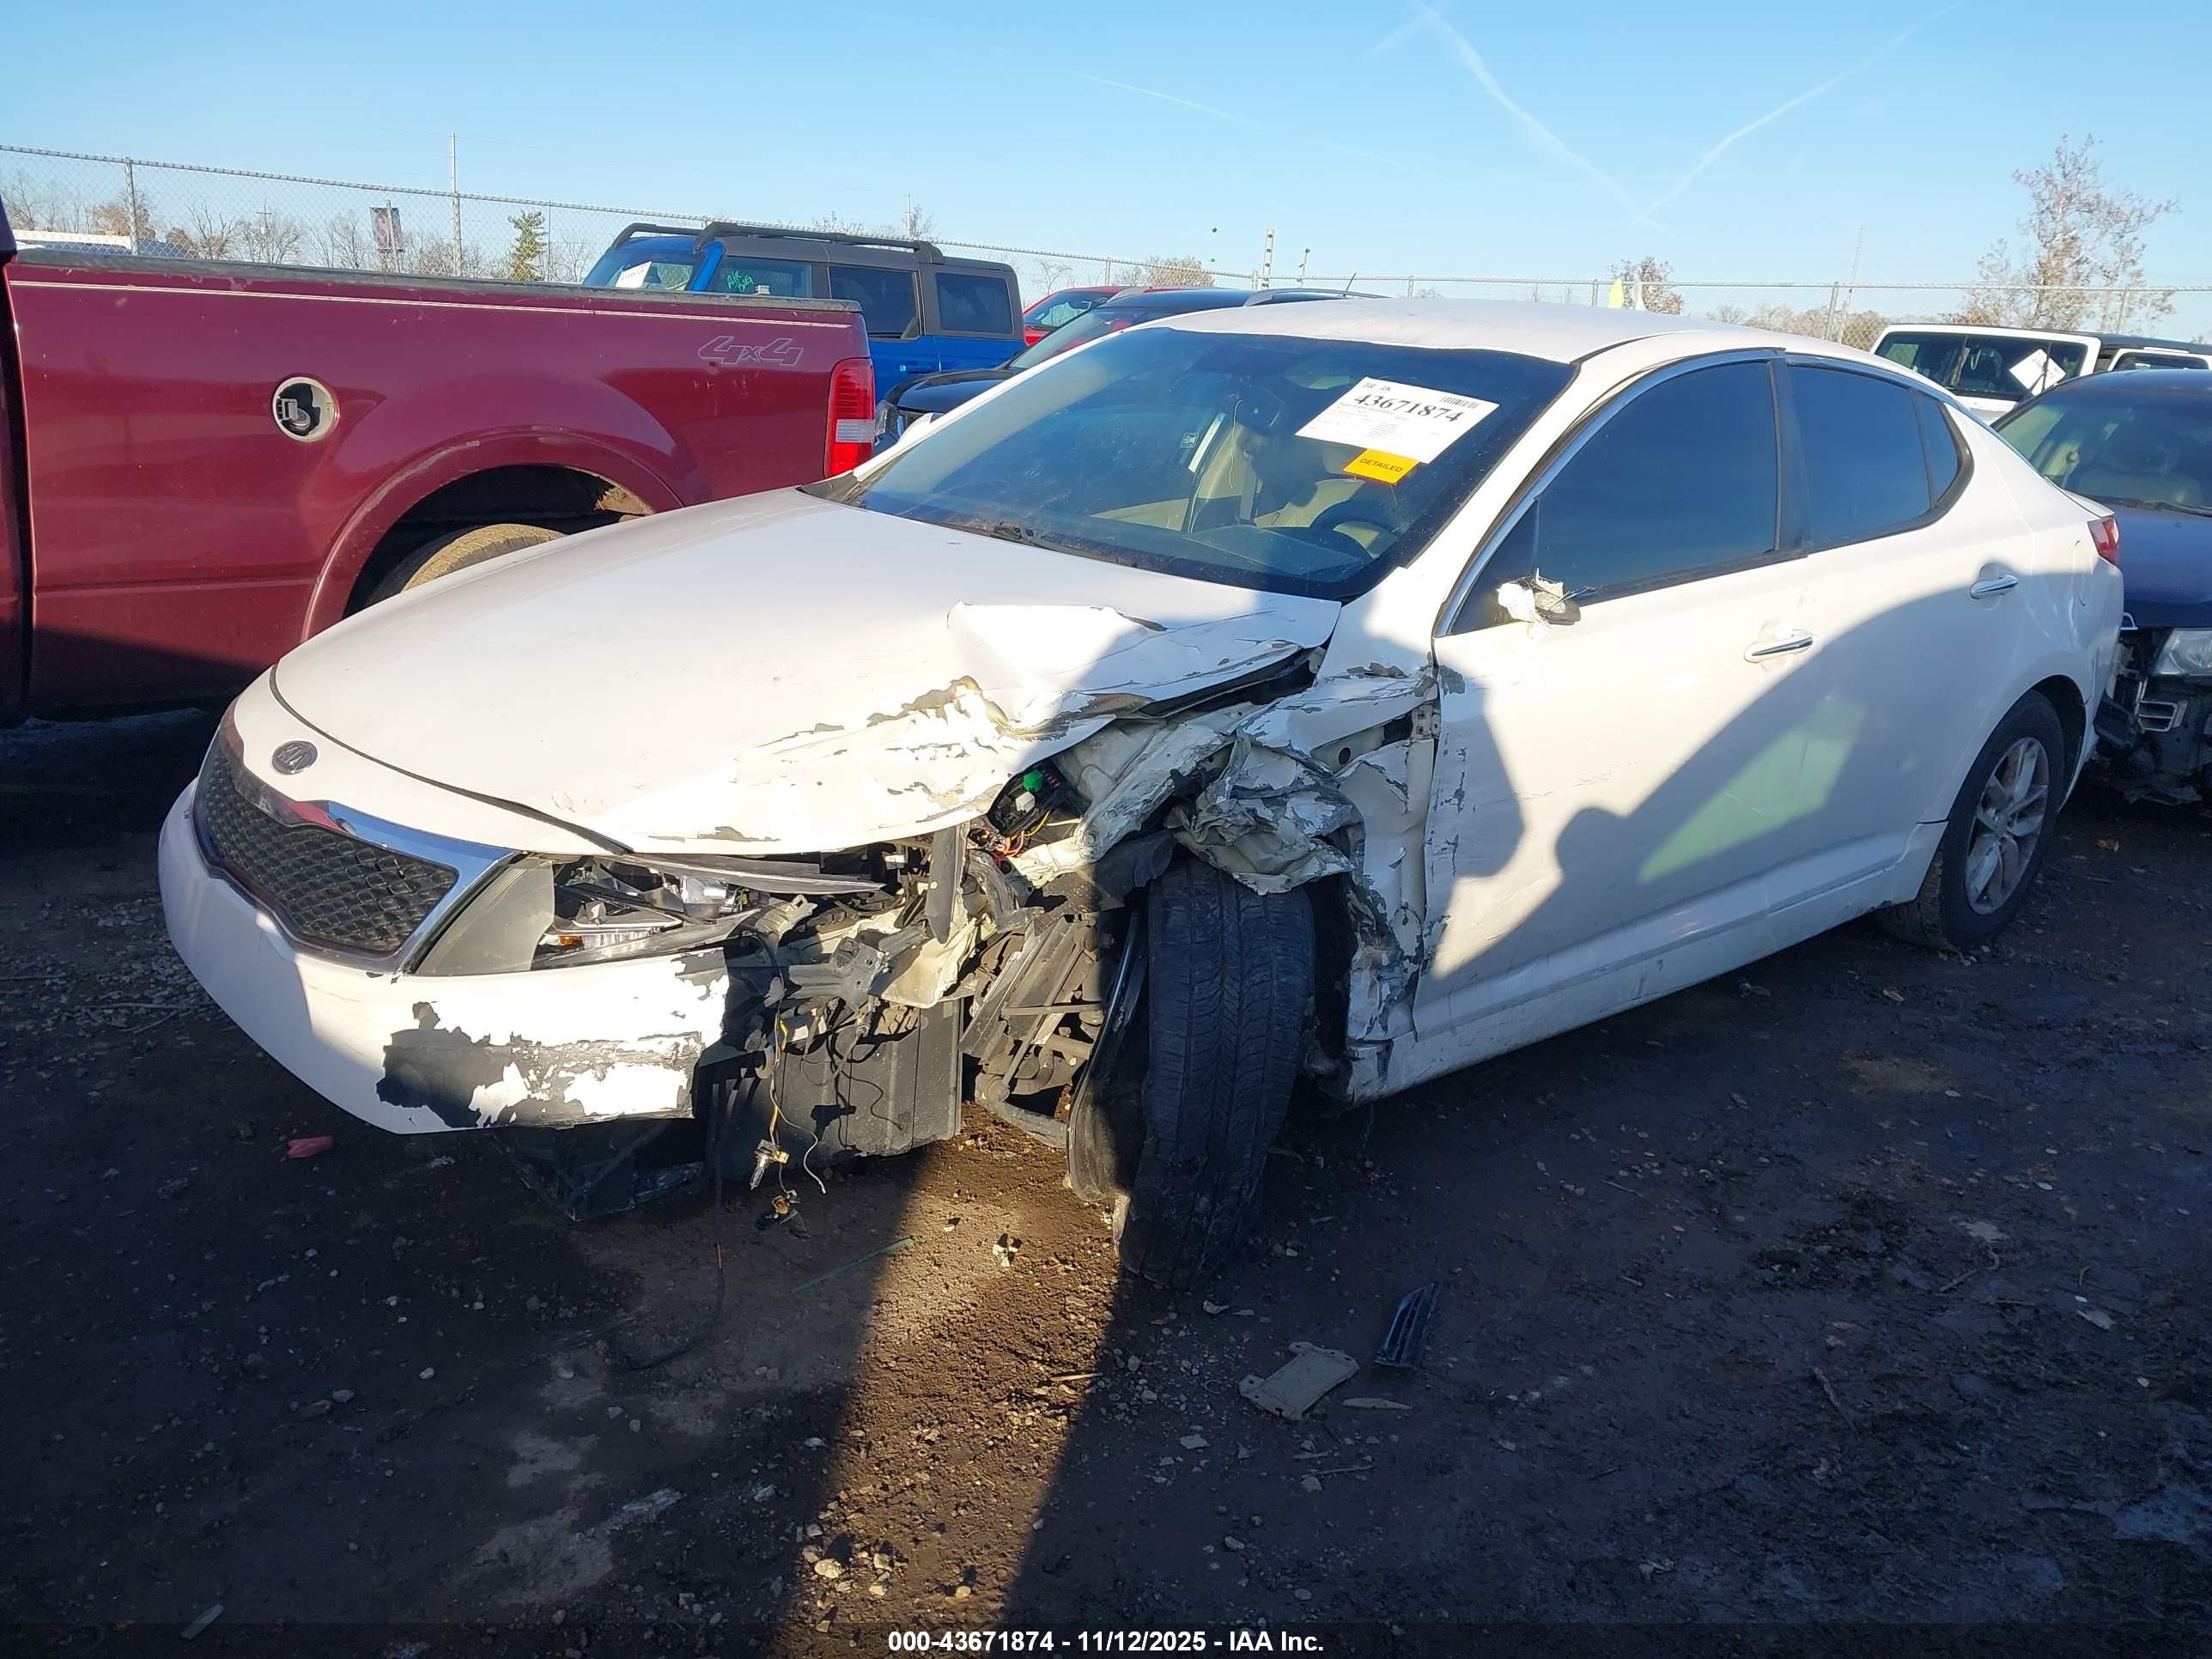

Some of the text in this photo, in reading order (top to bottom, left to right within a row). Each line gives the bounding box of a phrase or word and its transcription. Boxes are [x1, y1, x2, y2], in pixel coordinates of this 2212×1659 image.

[697, 336, 804, 366] 4x4
[1354, 393, 1464, 422] 43671874
[1359, 457, 1404, 473] DETAILED
